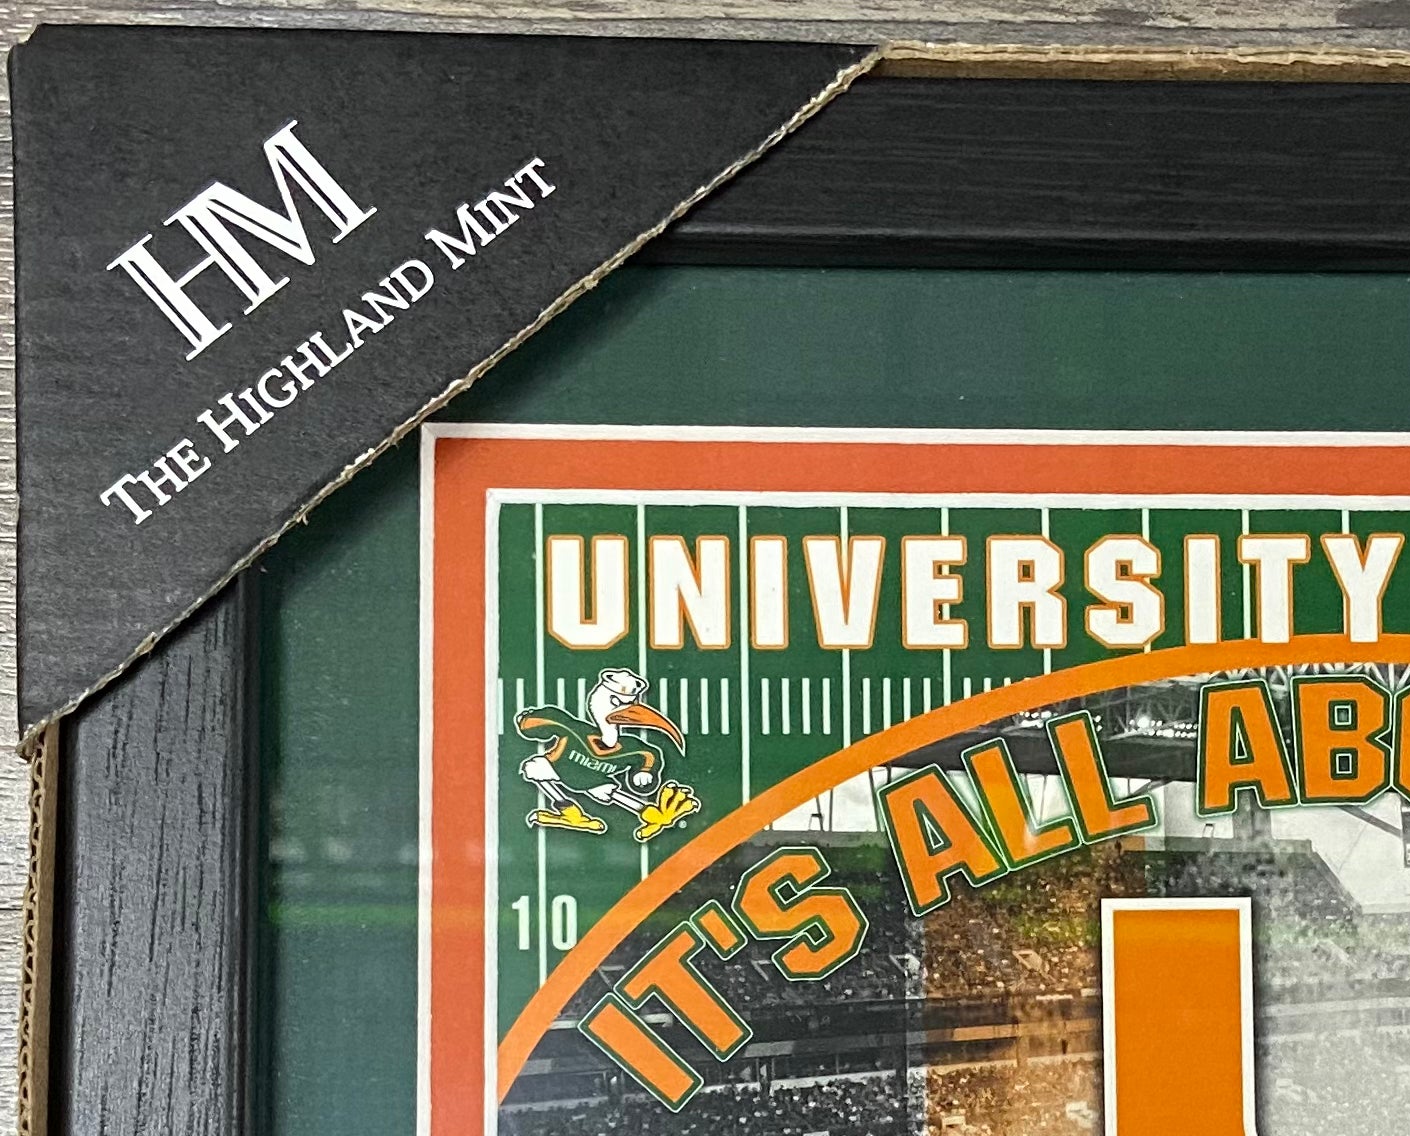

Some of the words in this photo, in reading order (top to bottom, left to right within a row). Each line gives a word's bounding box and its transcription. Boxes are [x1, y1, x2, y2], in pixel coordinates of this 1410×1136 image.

[107, 119, 377, 361] HM
[546, 531, 1406, 650] UNIVERSITY
[510, 893, 578, 951] 10
[578, 846, 870, 1113] IT'S
[877, 709, 1160, 917] ALL
